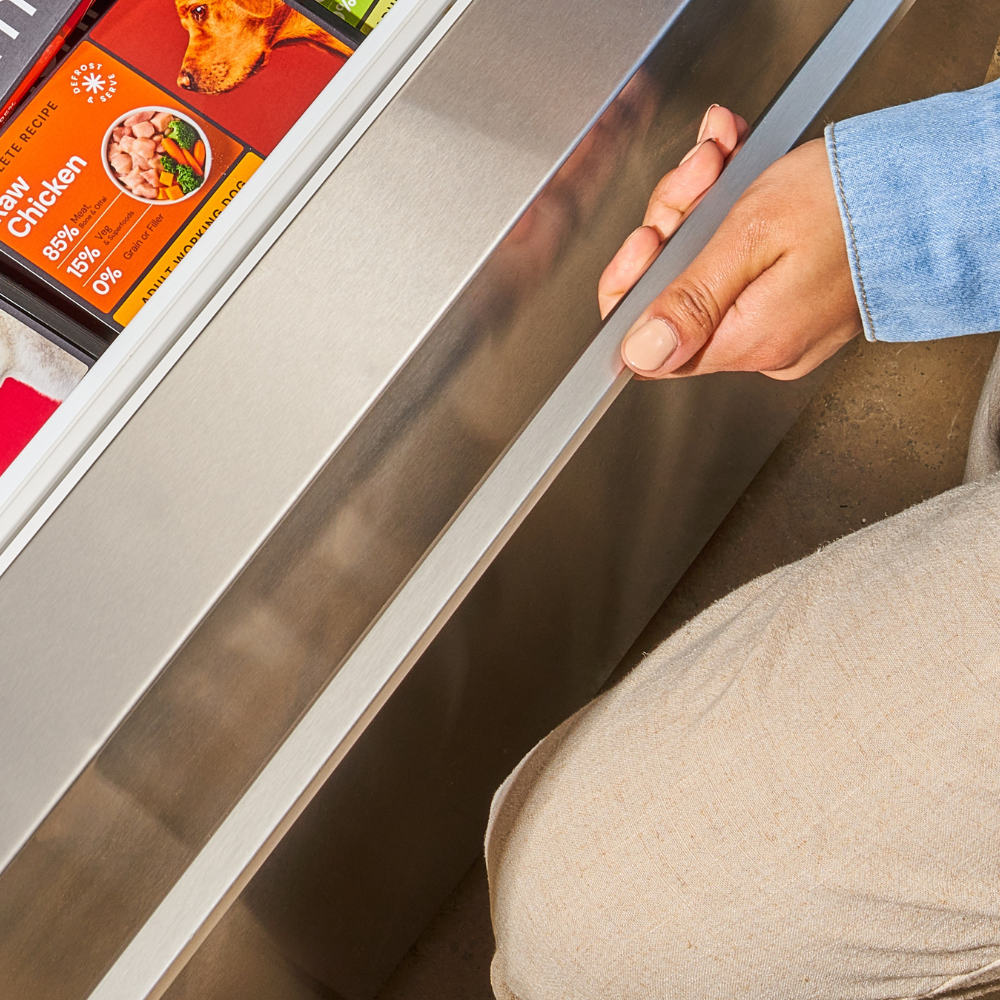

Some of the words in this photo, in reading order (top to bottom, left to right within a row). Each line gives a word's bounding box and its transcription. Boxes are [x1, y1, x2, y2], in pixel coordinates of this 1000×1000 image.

[71, 62, 103, 94] DEFROST
[100, 73, 118, 102] SERVE
[20, 101, 59, 142] RECIPE
[7, 154, 88, 237] Chicken
[221, 181, 245, 207] DOG
[42, 224, 80, 261] 85%
[70, 203, 92, 224] Meat,
[107, 210, 135, 241] Superfoods
[66, 246, 101, 278] 15%
[94, 224, 113, 242] Veg
[92, 266, 123, 296] 0%
[123, 237, 146, 261] Grain
[141, 230, 150, 240] or
[148, 213, 165, 233] Filler
